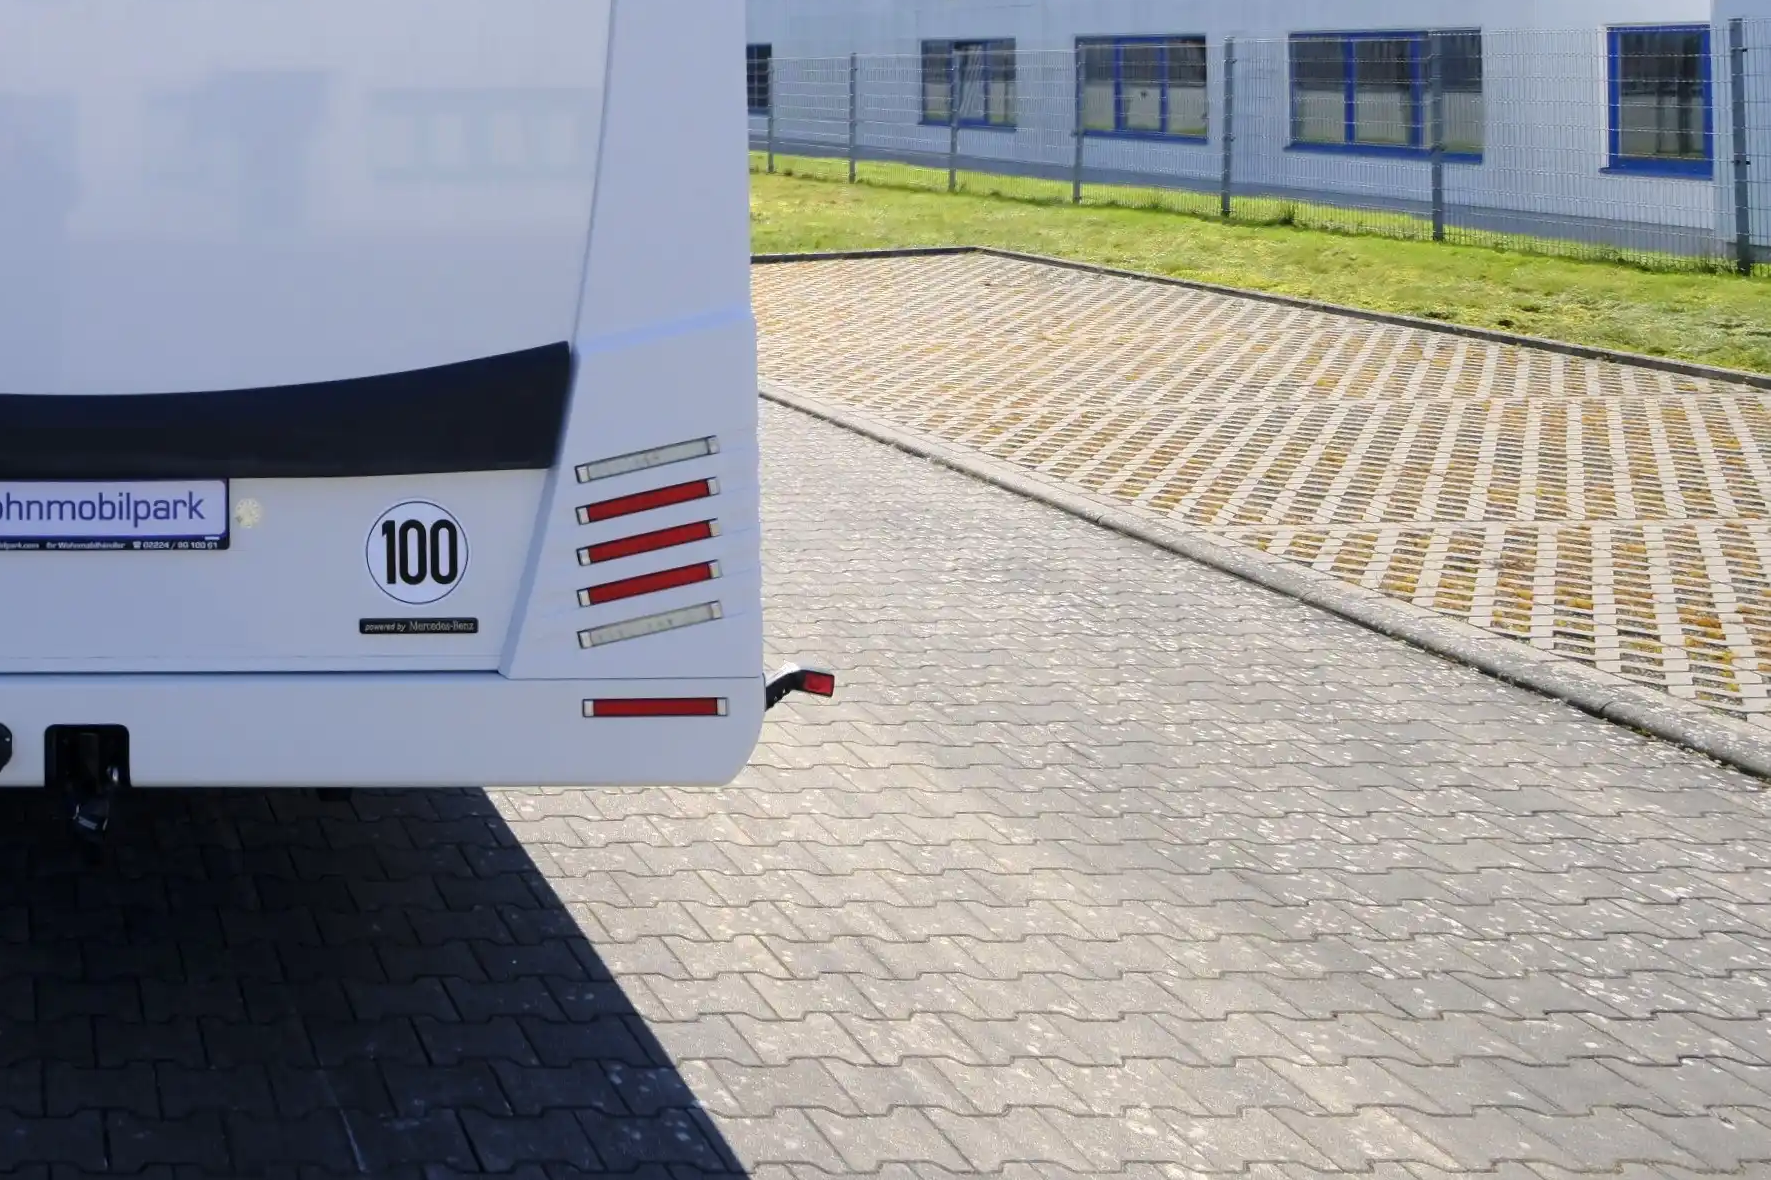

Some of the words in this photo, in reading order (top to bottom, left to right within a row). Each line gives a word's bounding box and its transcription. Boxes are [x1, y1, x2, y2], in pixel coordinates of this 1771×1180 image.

[381, 519, 458, 585] 100
[364, 623, 396, 632] powered
[396, 622, 406, 632] by
[410, 620, 475, 632] Mercedes-Benz
